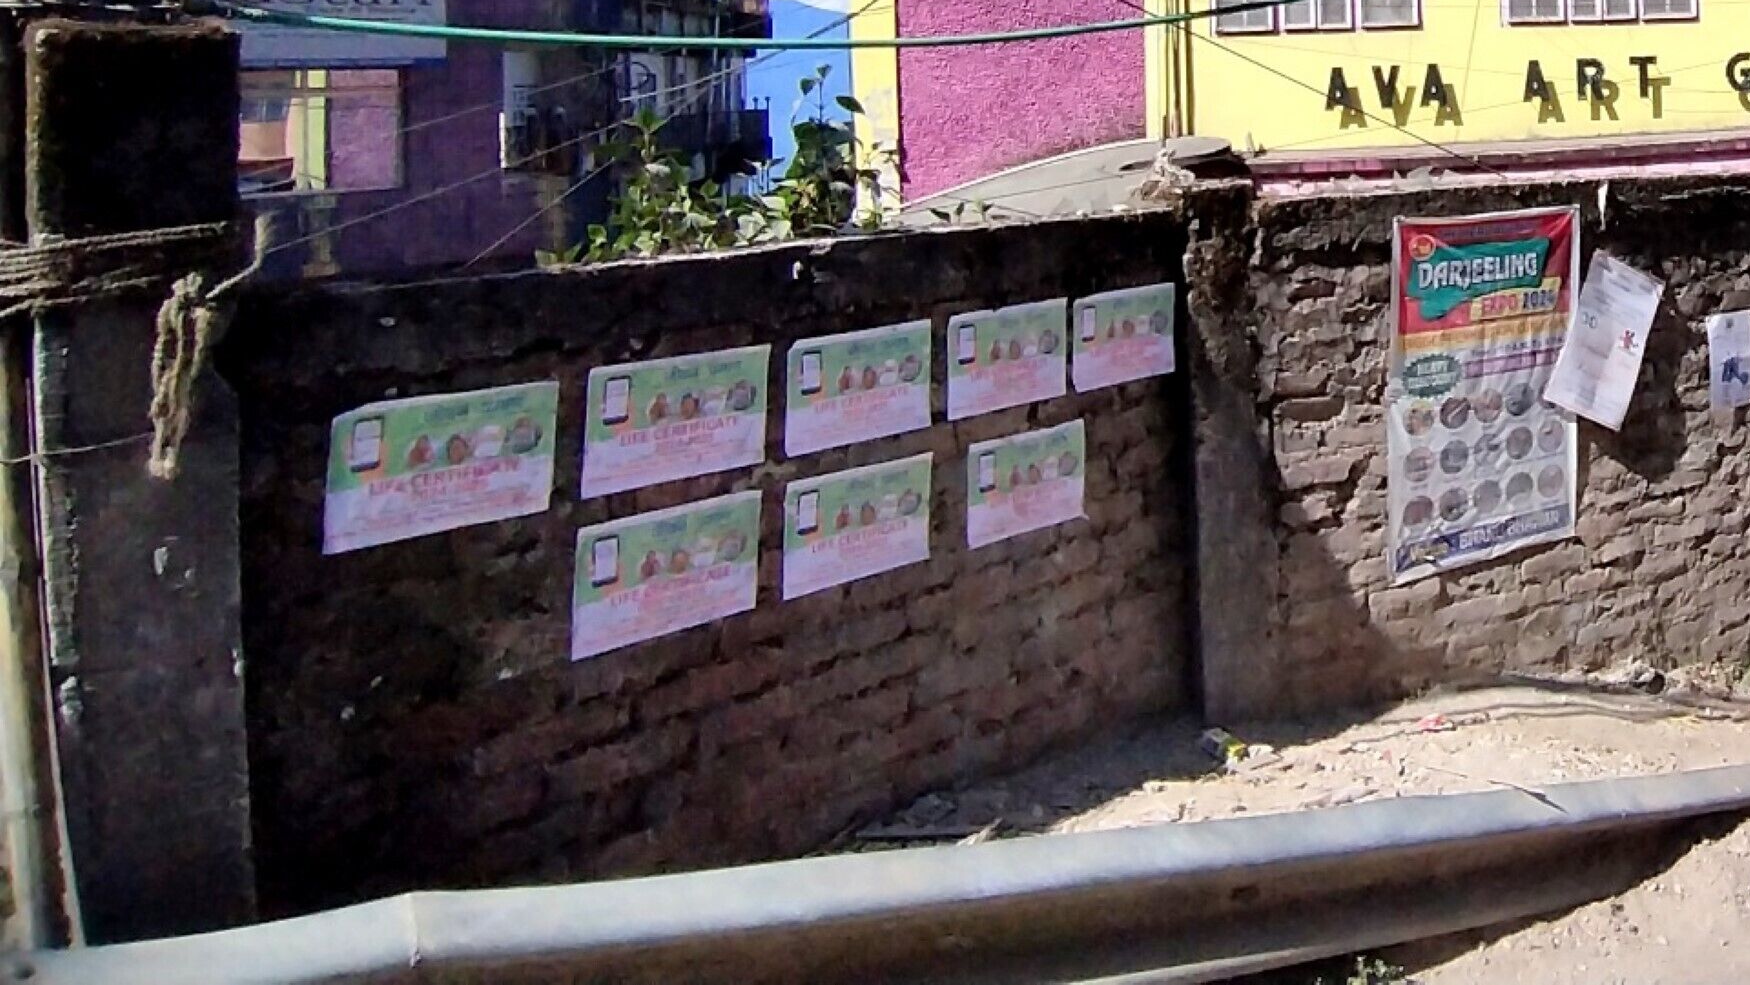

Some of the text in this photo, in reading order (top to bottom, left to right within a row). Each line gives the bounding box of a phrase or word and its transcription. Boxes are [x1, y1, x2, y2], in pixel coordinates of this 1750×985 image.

[1325, 63, 1447, 111] AVA
[1523, 56, 1657, 102] ART
[1417, 252, 1538, 290] DARJEELING
